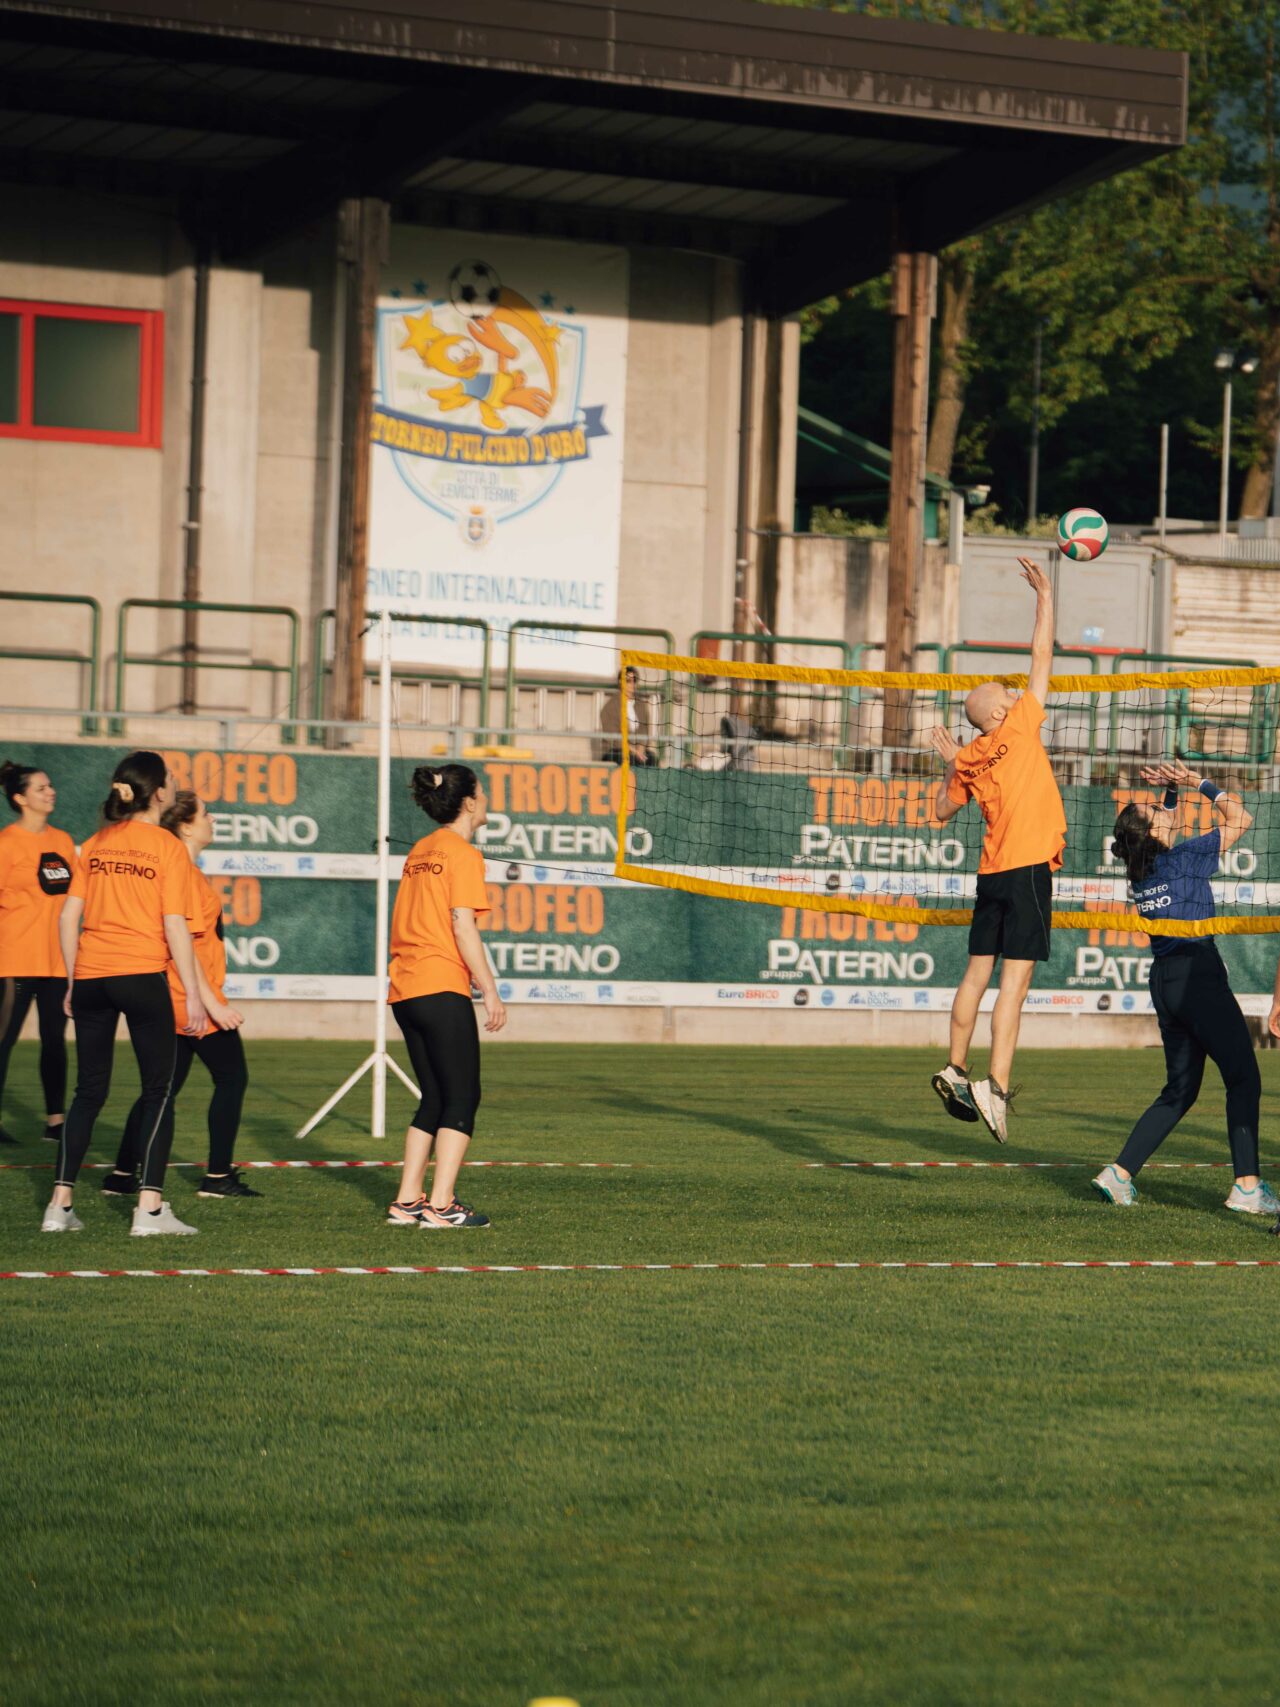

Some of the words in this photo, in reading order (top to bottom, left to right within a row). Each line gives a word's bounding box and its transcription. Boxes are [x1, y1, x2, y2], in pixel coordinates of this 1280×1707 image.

[369, 412, 448, 457] TORNEO
[449, 432, 529, 464] PULCINO
[531, 429, 586, 462] D'ORO
[368, 568, 421, 598] RNEO
[429, 572, 605, 610] INTERNAZIONALE
[158, 751, 297, 806] ROFEO
[483, 763, 637, 816] TROFEO
[213, 812, 319, 846] ERNO
[476, 813, 653, 859] PATERNO
[801, 825, 965, 870] PATERNO
[90, 858, 156, 880] PATERNO
[1096, 865, 1128, 874] grupp
[478, 883, 604, 935] ROFEO
[1137, 895, 1171, 913] TERNO
[760, 970, 803, 979] gruppo
[768, 939, 934, 985] PATERNO
[1067, 976, 1107, 986] gruppo
[1076, 946, 1151, 990] PATE
